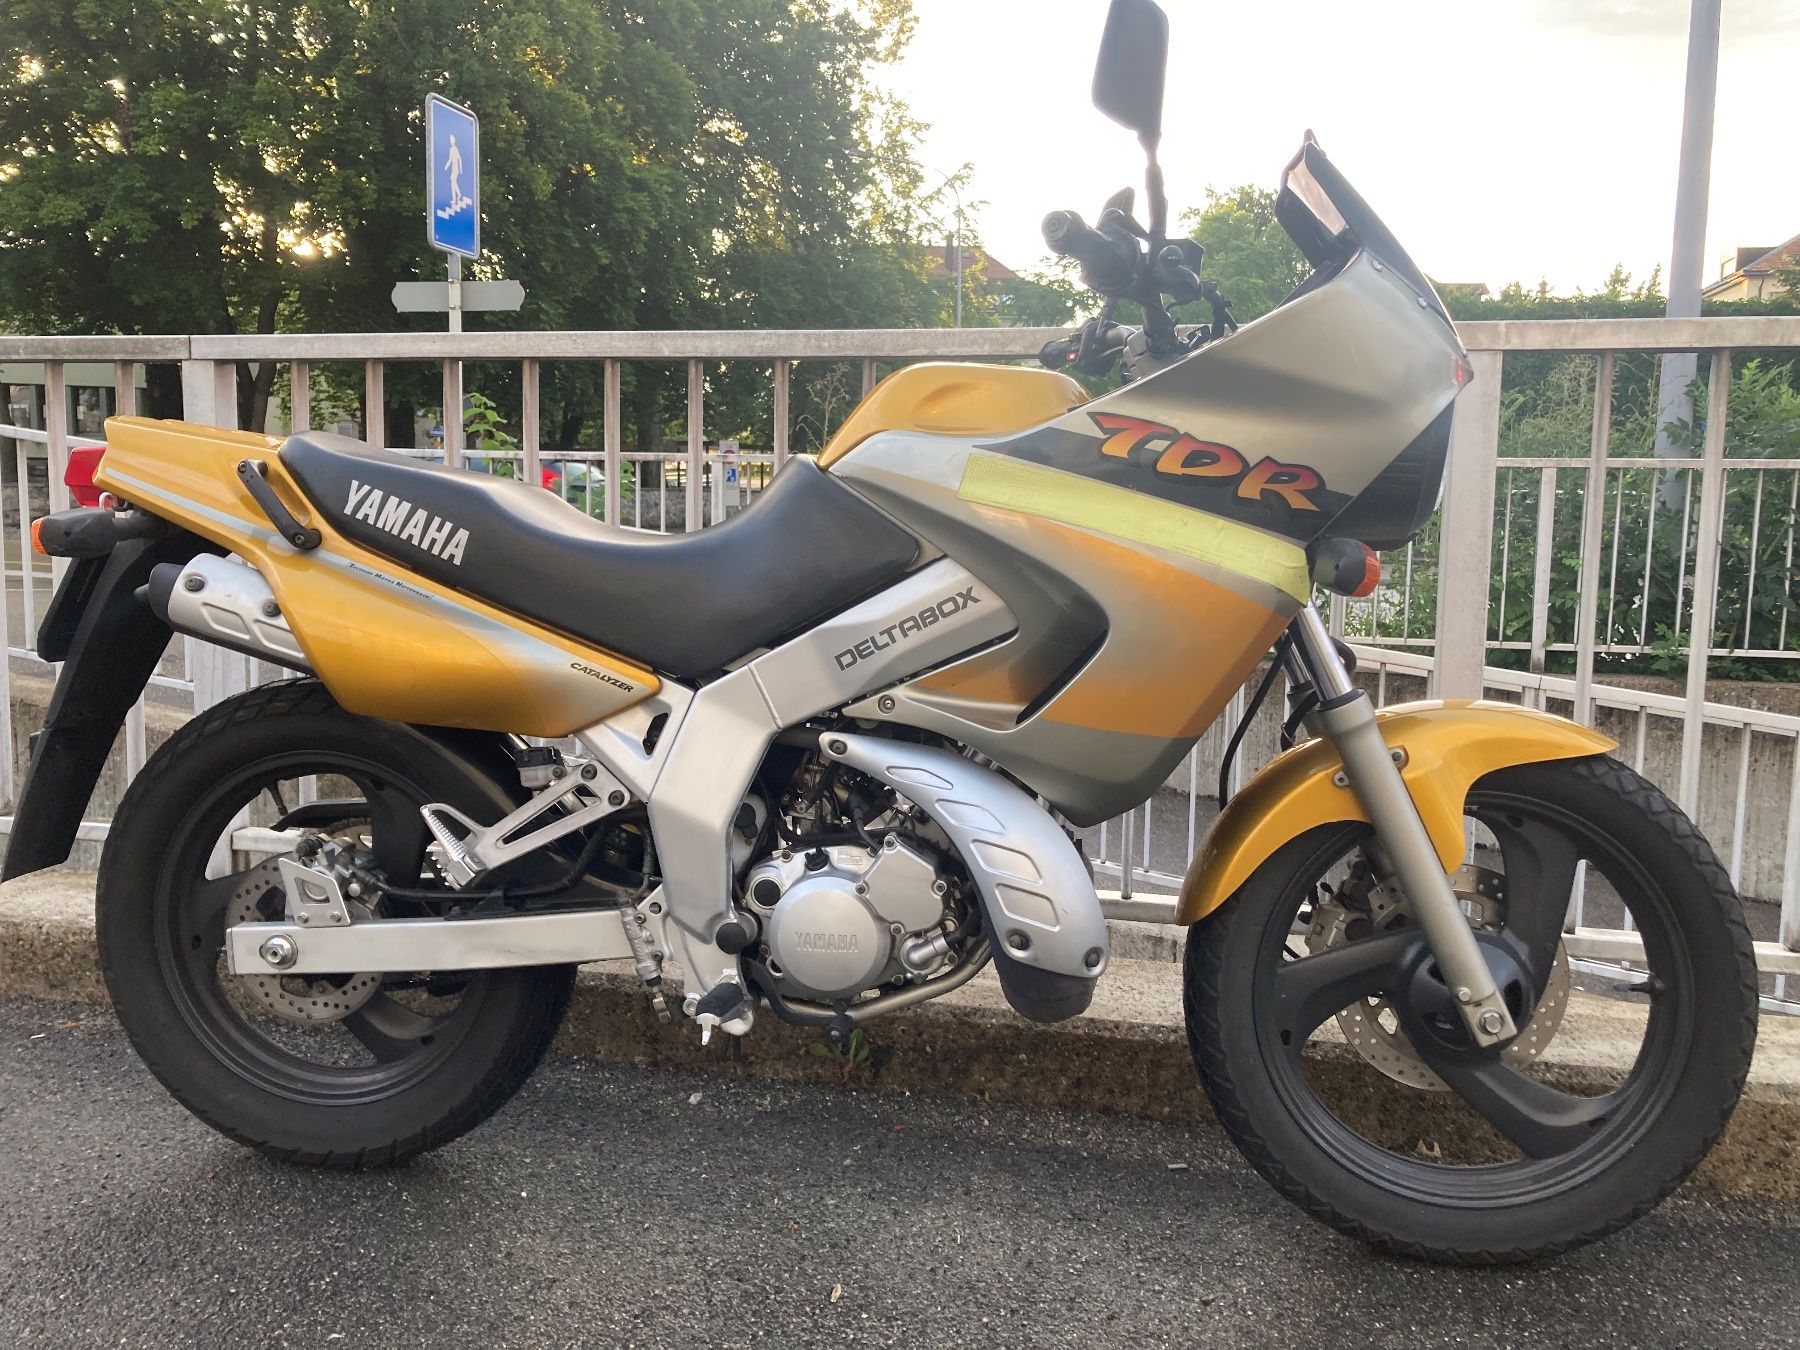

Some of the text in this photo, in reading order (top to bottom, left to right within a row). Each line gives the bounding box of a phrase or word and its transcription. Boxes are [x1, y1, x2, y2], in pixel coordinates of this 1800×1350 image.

[1087, 402, 1325, 512] TDR
[343, 479, 470, 566] YAMAHA
[834, 585, 981, 671] DELTABOX
[570, 662, 634, 693] CATALYZER
[794, 930, 858, 953] YAMAHA
